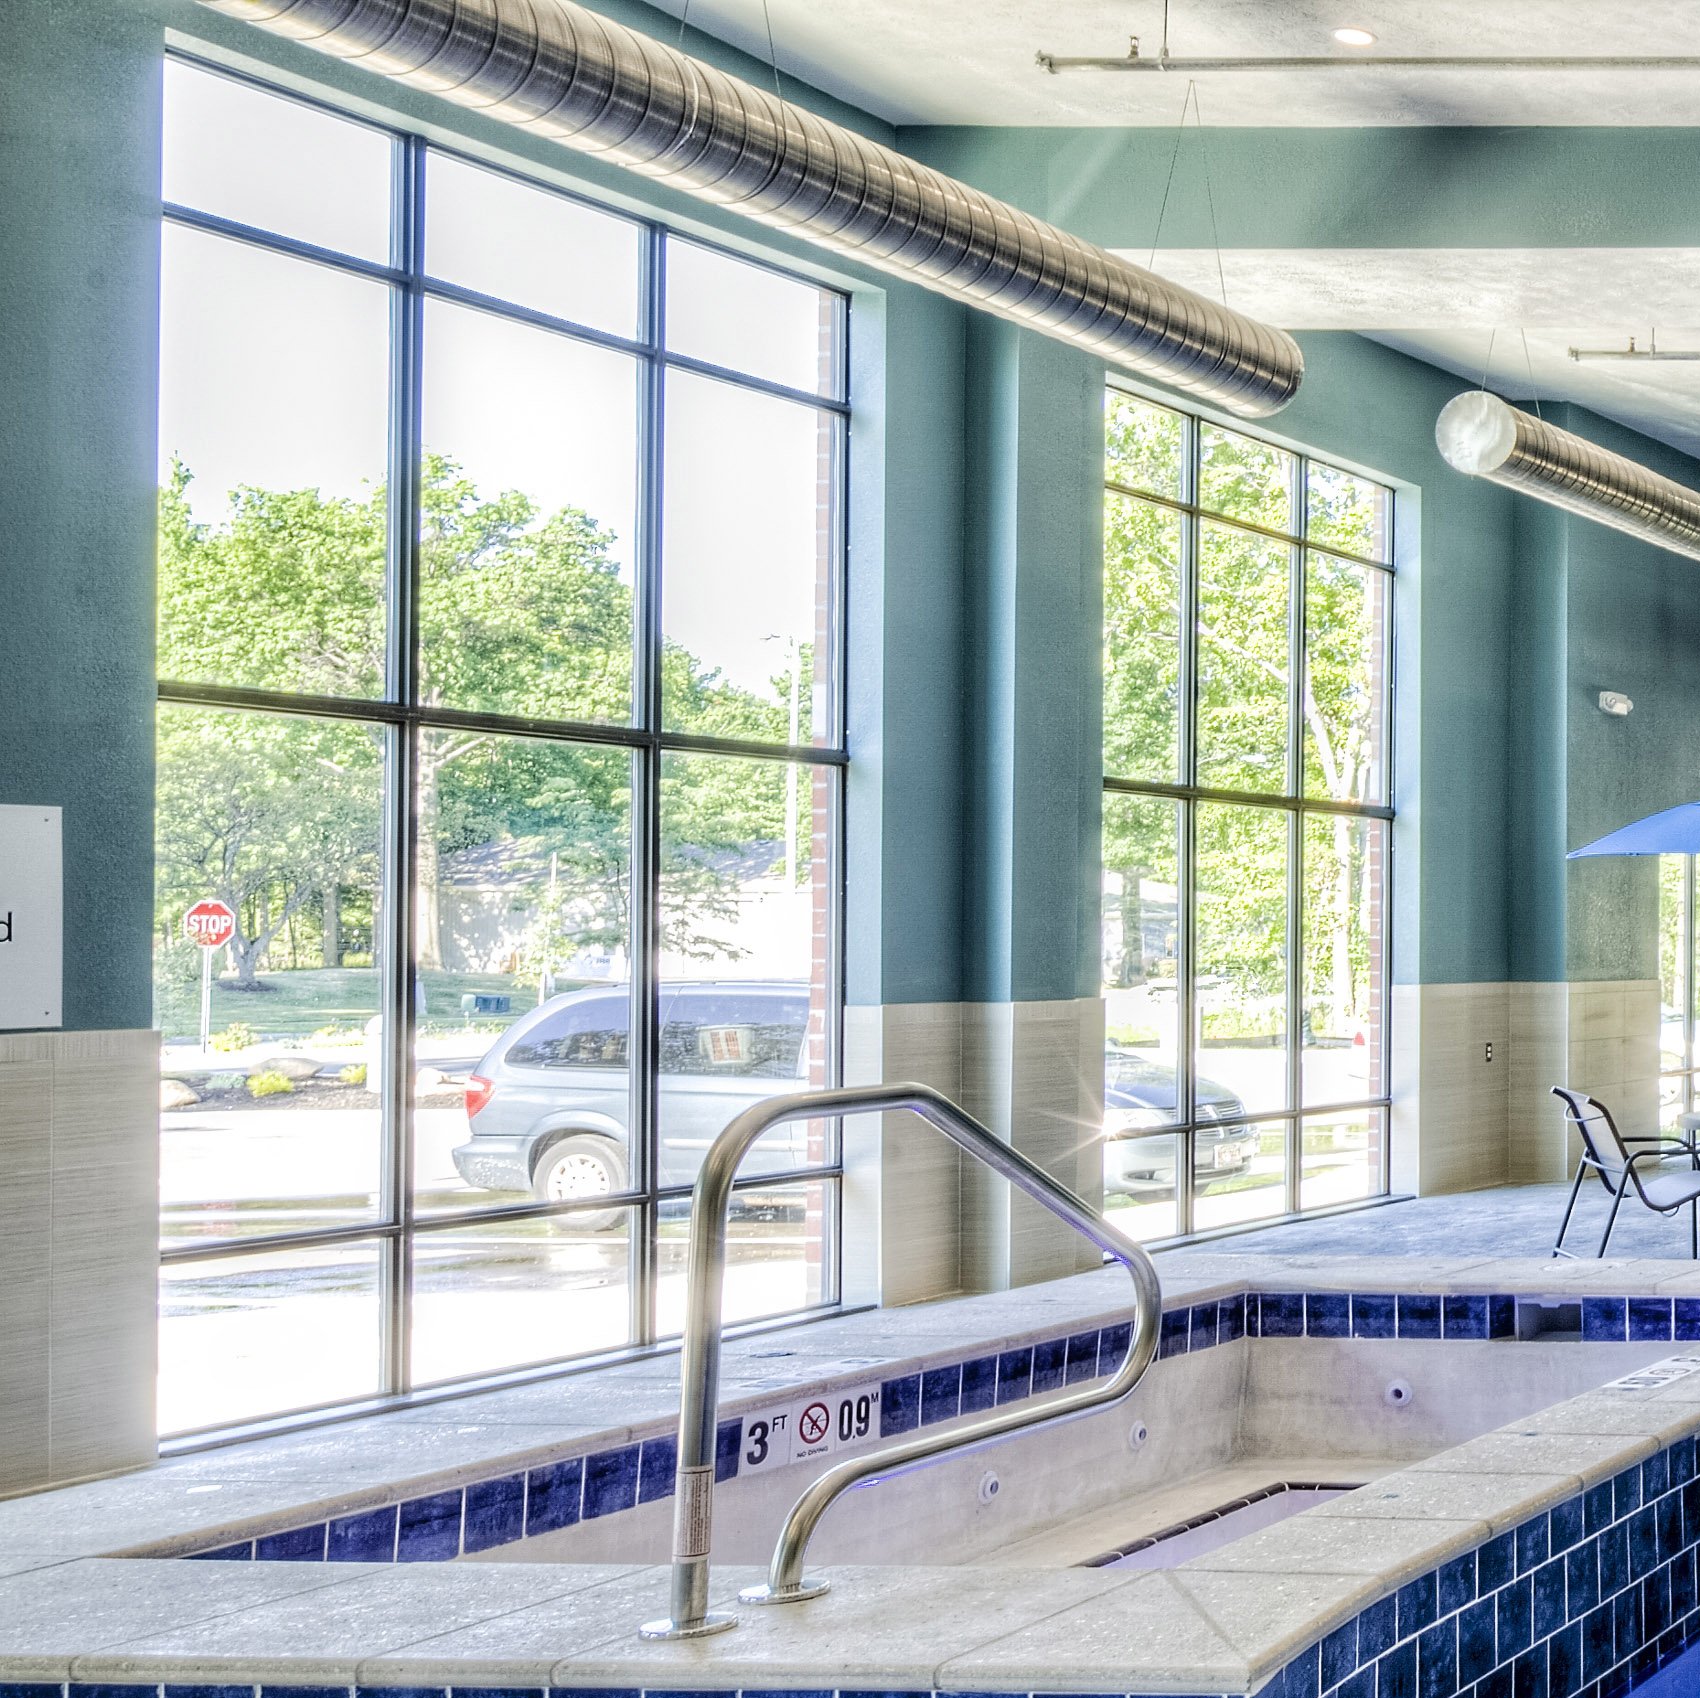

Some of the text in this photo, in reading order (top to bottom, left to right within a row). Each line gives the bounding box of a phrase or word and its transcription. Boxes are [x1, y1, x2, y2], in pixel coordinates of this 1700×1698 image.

[189, 915, 232, 934] STOP
[746, 1414, 788, 1466] 3 FT
[838, 1392, 880, 1442] 0.9 M
